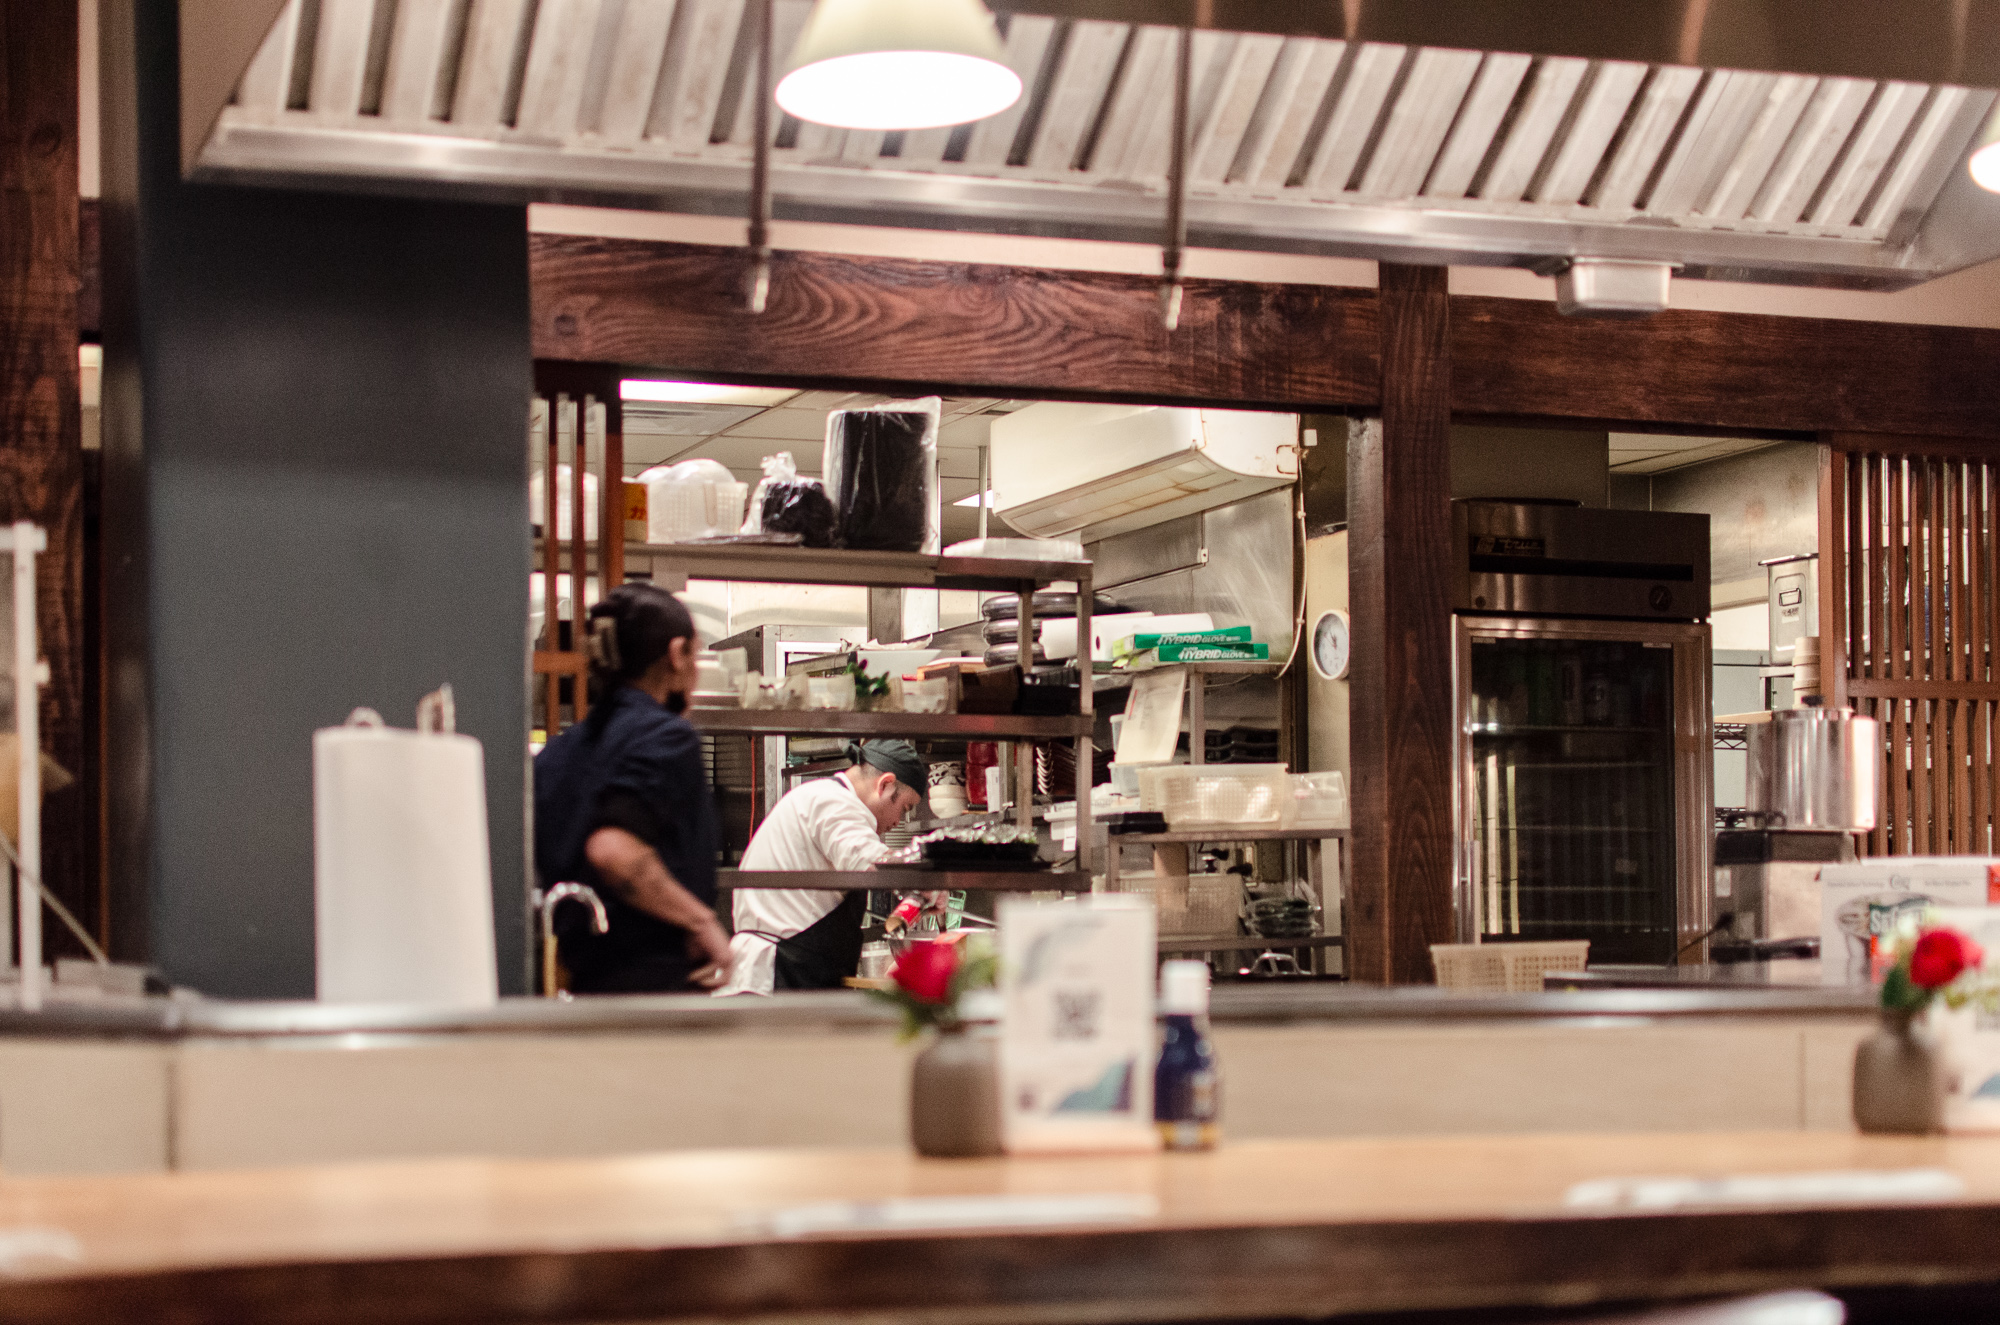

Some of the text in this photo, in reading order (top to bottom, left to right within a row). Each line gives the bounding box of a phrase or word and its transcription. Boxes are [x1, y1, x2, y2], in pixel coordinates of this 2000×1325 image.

[1157, 634, 1202, 645] HYBRID
[1178, 649, 1221, 660] HYBRID
[1221, 650, 1245, 659] GLOVE
